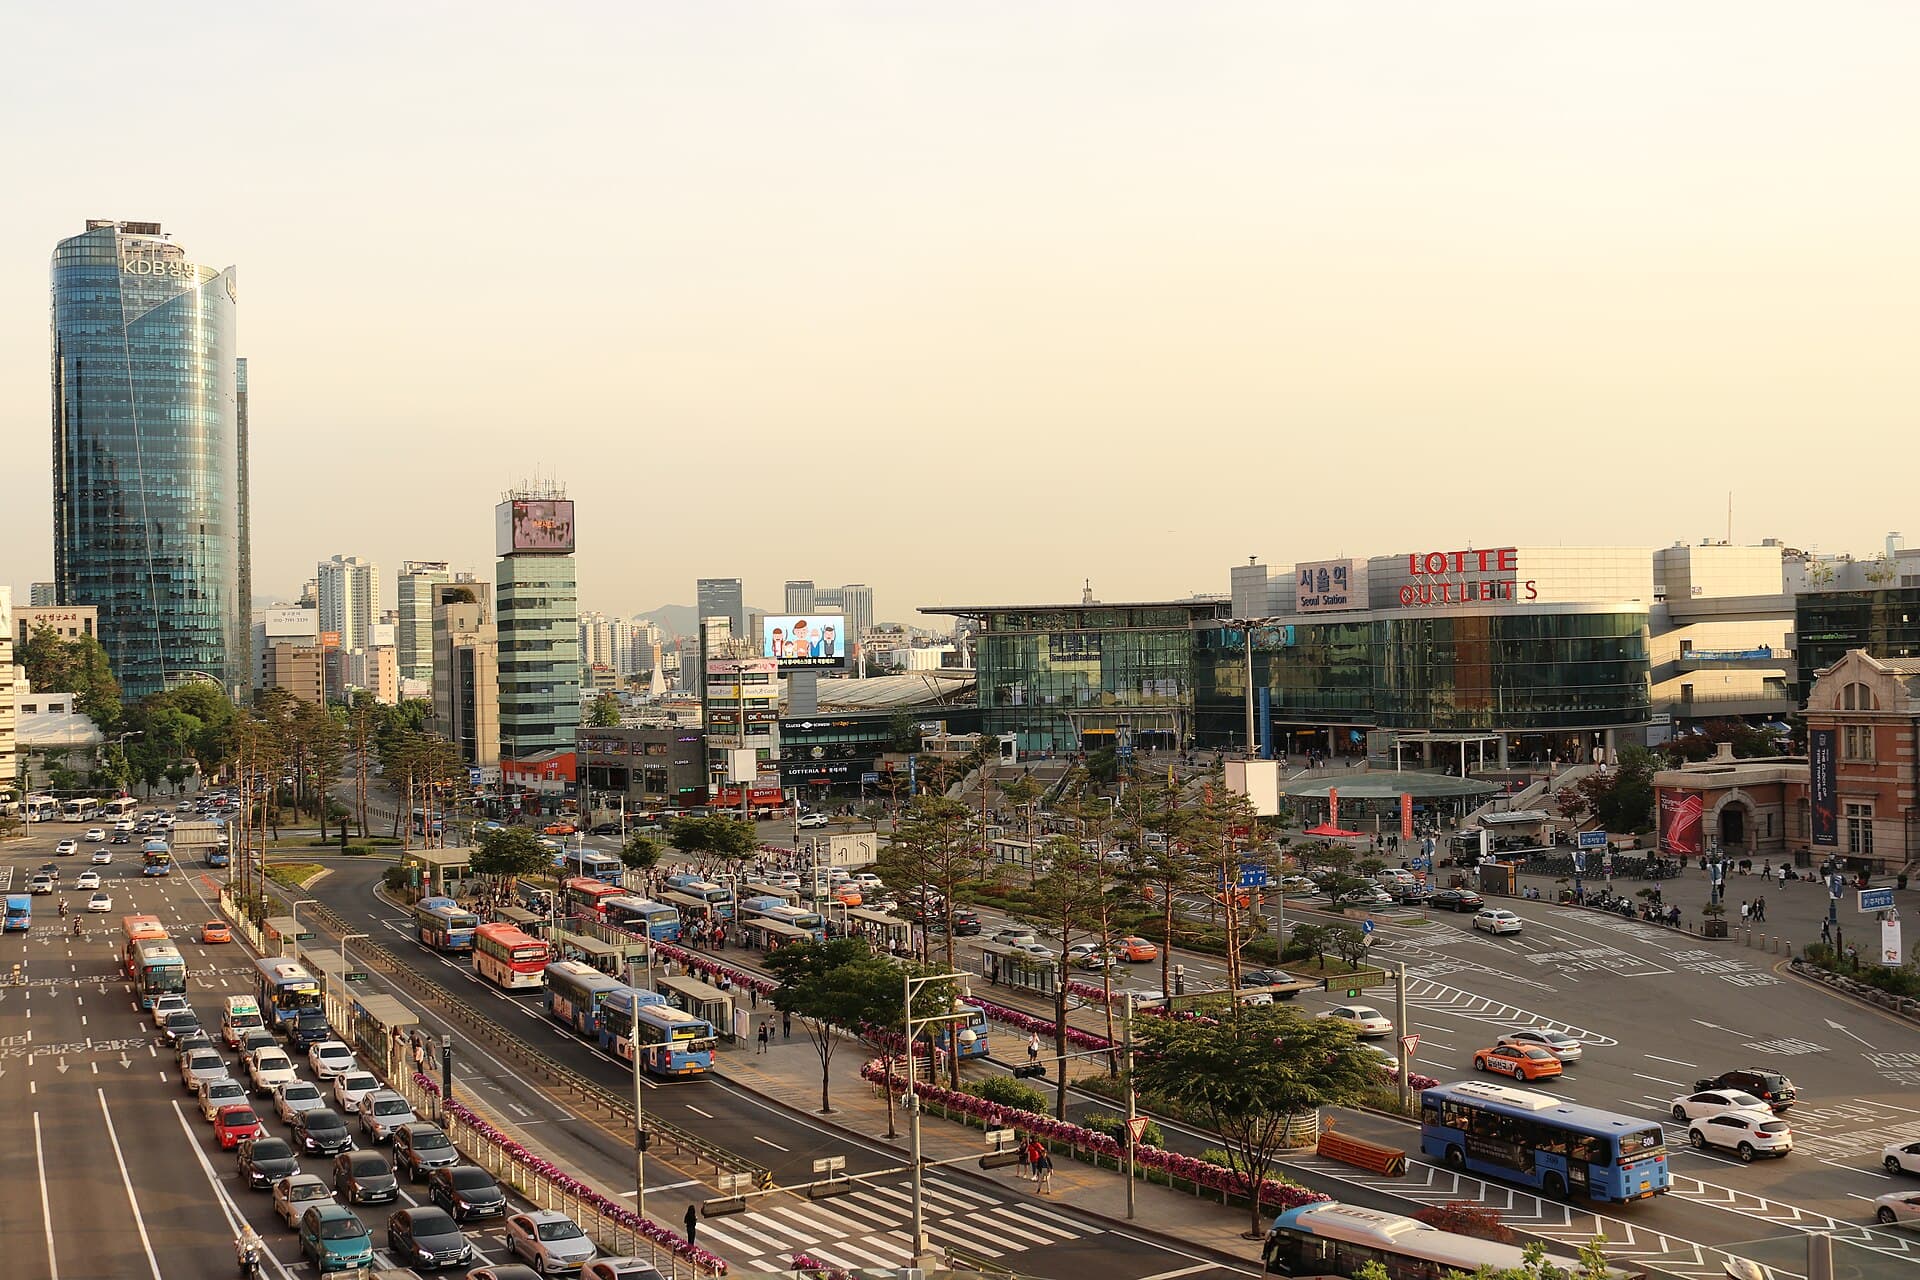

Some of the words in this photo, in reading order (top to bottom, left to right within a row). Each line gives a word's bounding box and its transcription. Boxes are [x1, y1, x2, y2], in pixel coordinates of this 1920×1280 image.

[123, 259, 165, 275] KDB
[1409, 548, 1518, 575] LOTTE
[1300, 566, 1347, 593] 서울역
[1300, 596, 1320, 607] Seoul
[1322, 594, 1347, 605] Station
[1399, 580, 1538, 605] OUTLETS
[1328, 973, 1384, 990] 버스전용차로
[444, 1048, 450, 1057] 7
[1642, 1136, 1655, 1147] 500
